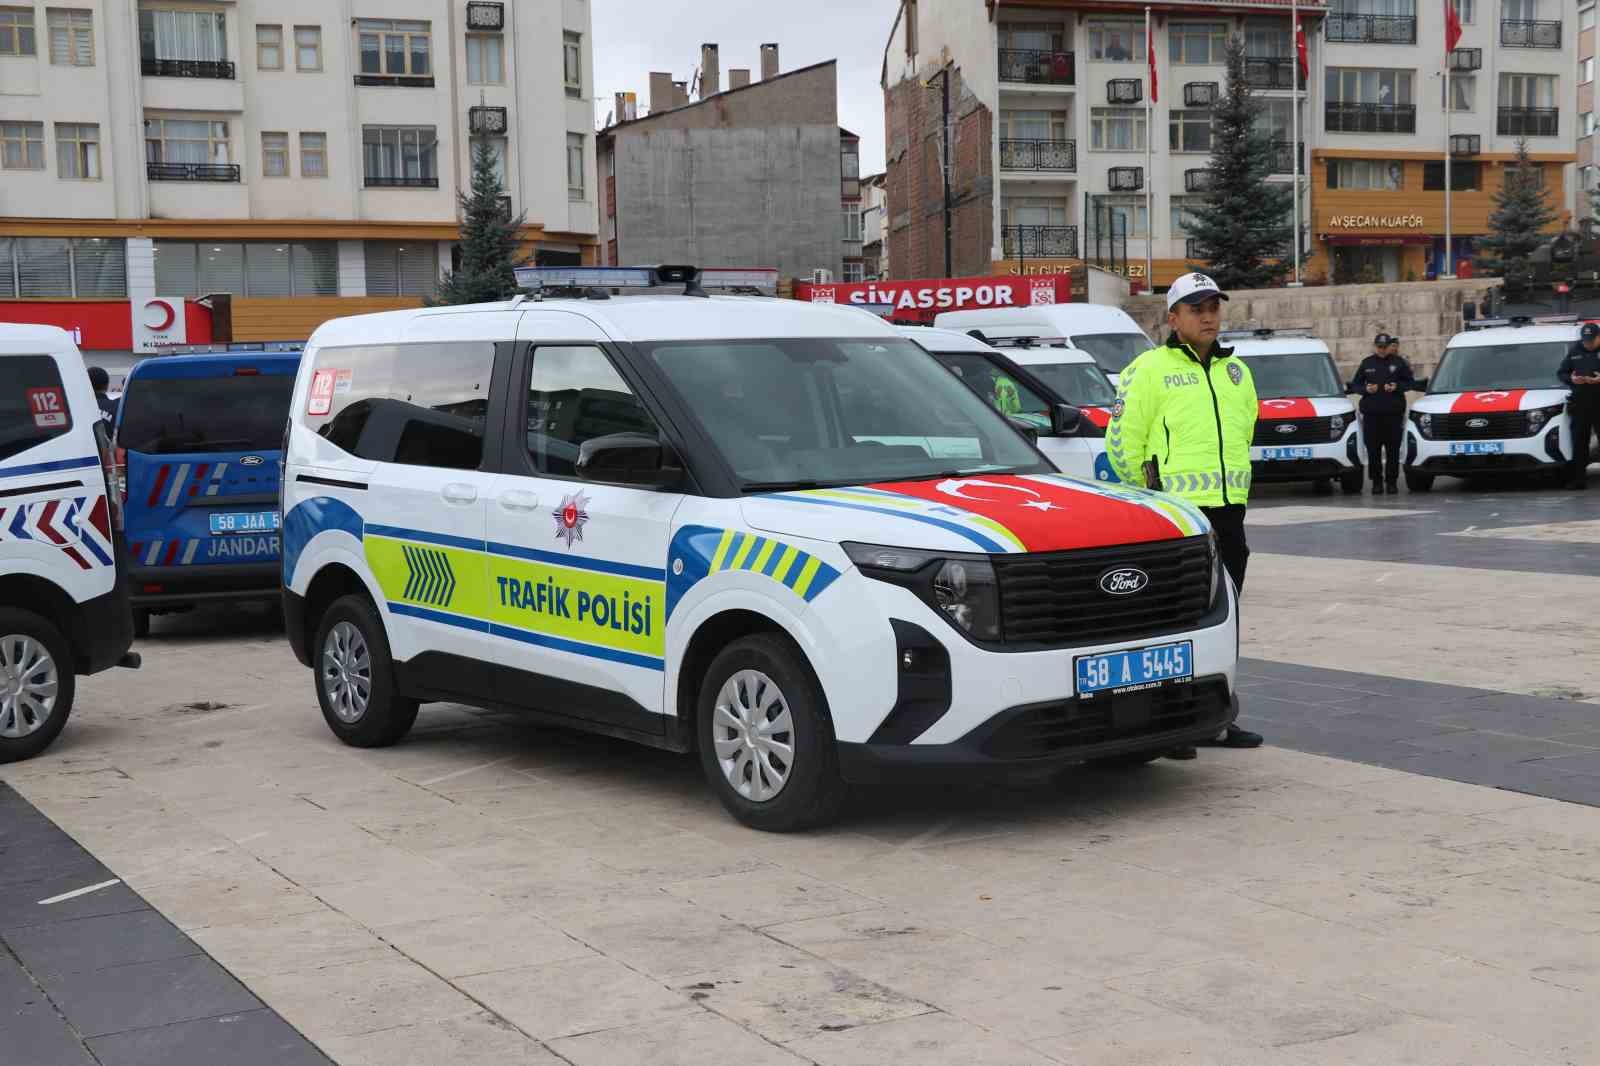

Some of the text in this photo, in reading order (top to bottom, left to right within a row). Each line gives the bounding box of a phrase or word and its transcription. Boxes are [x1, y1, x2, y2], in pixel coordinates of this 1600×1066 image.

[849, 285, 1013, 309] SİVASSPOR
[1164, 372, 1199, 389] POLİS
[32, 391, 60, 411] 112
[219, 515, 234, 529] 58
[242, 514, 265, 529] JAA
[208, 536, 281, 557] JANDAR
[1110, 572, 1139, 590] Ford
[496, 575, 651, 637] TRAFİK POLİSİ
[1087, 647, 1185, 688] 58 A 5445
